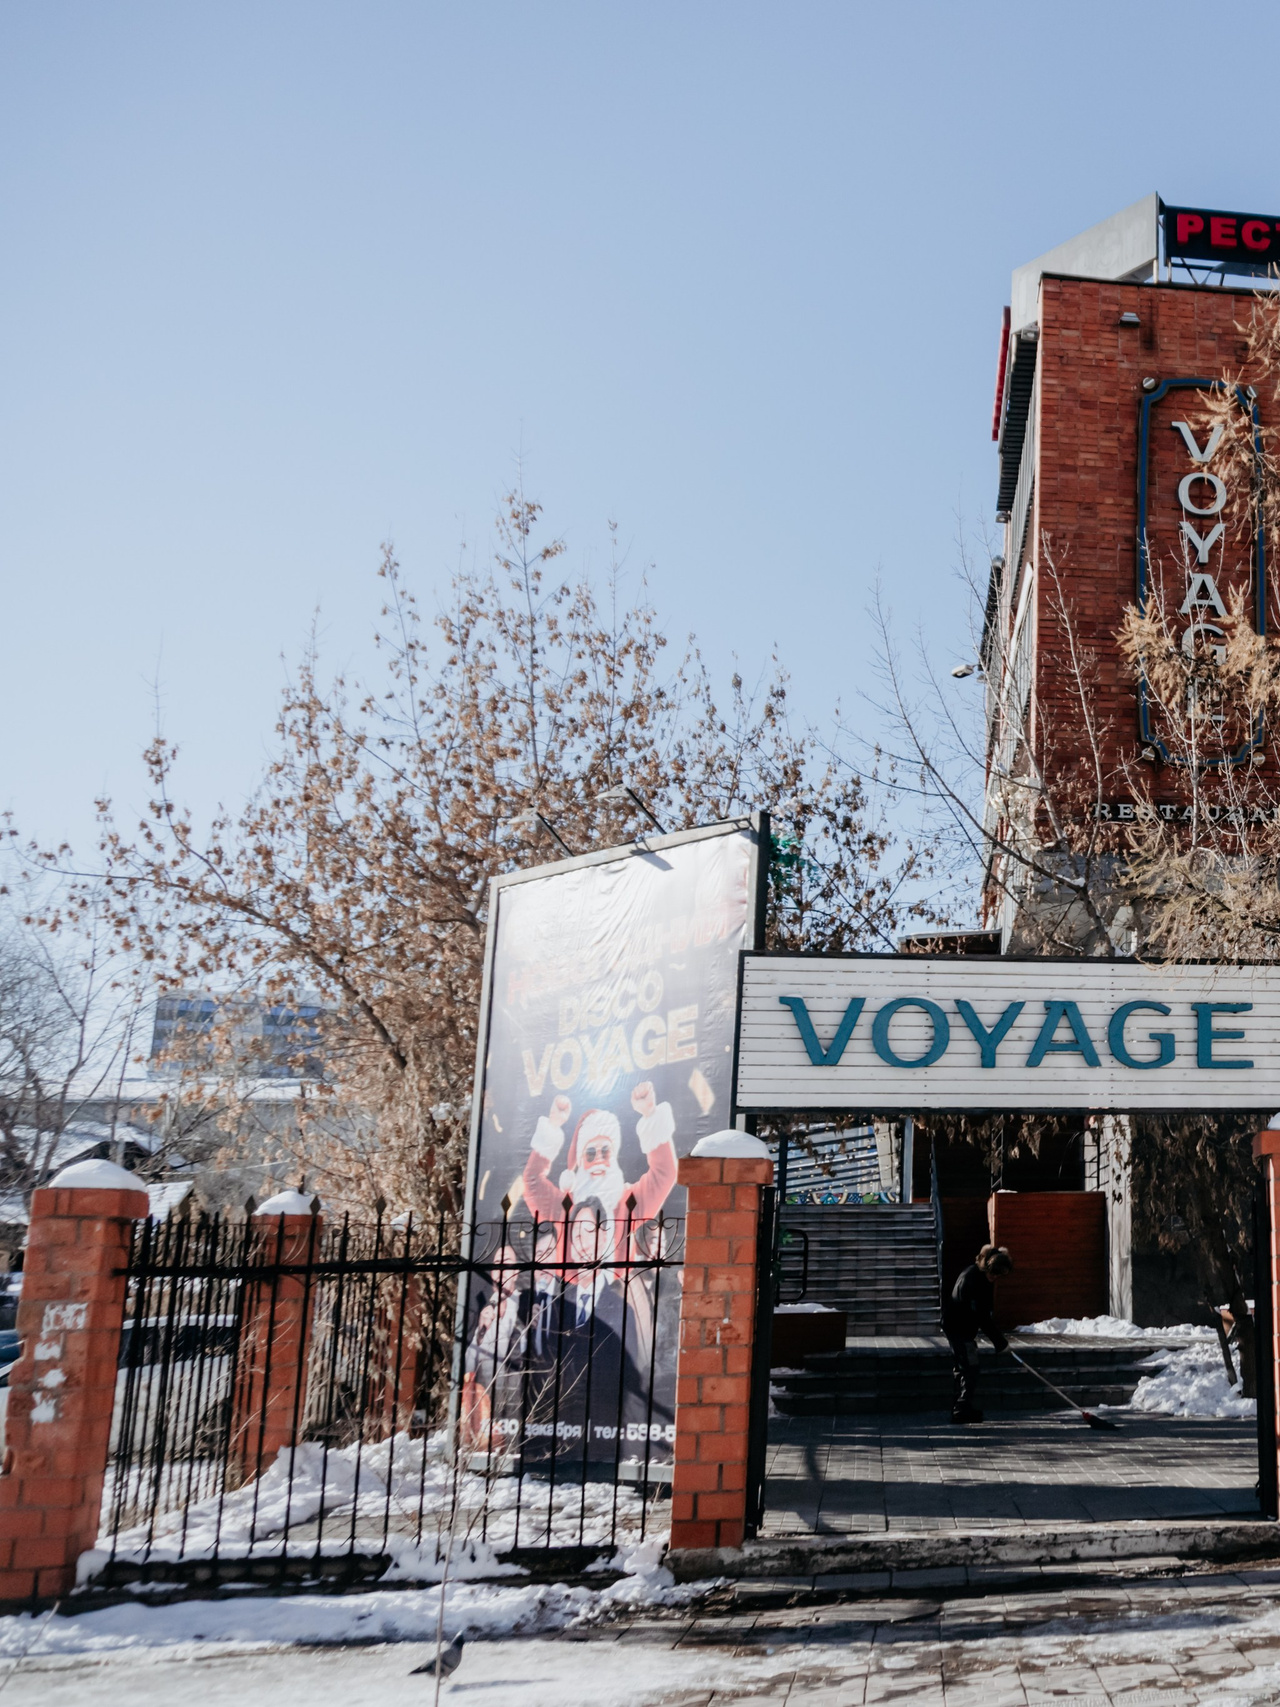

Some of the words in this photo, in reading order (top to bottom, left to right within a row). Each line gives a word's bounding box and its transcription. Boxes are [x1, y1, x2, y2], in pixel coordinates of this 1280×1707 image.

[558, 970, 664, 1036] DISCO
[779, 995, 1254, 1069] VOYAGE
[522, 1004, 699, 1098] VOYAGE
